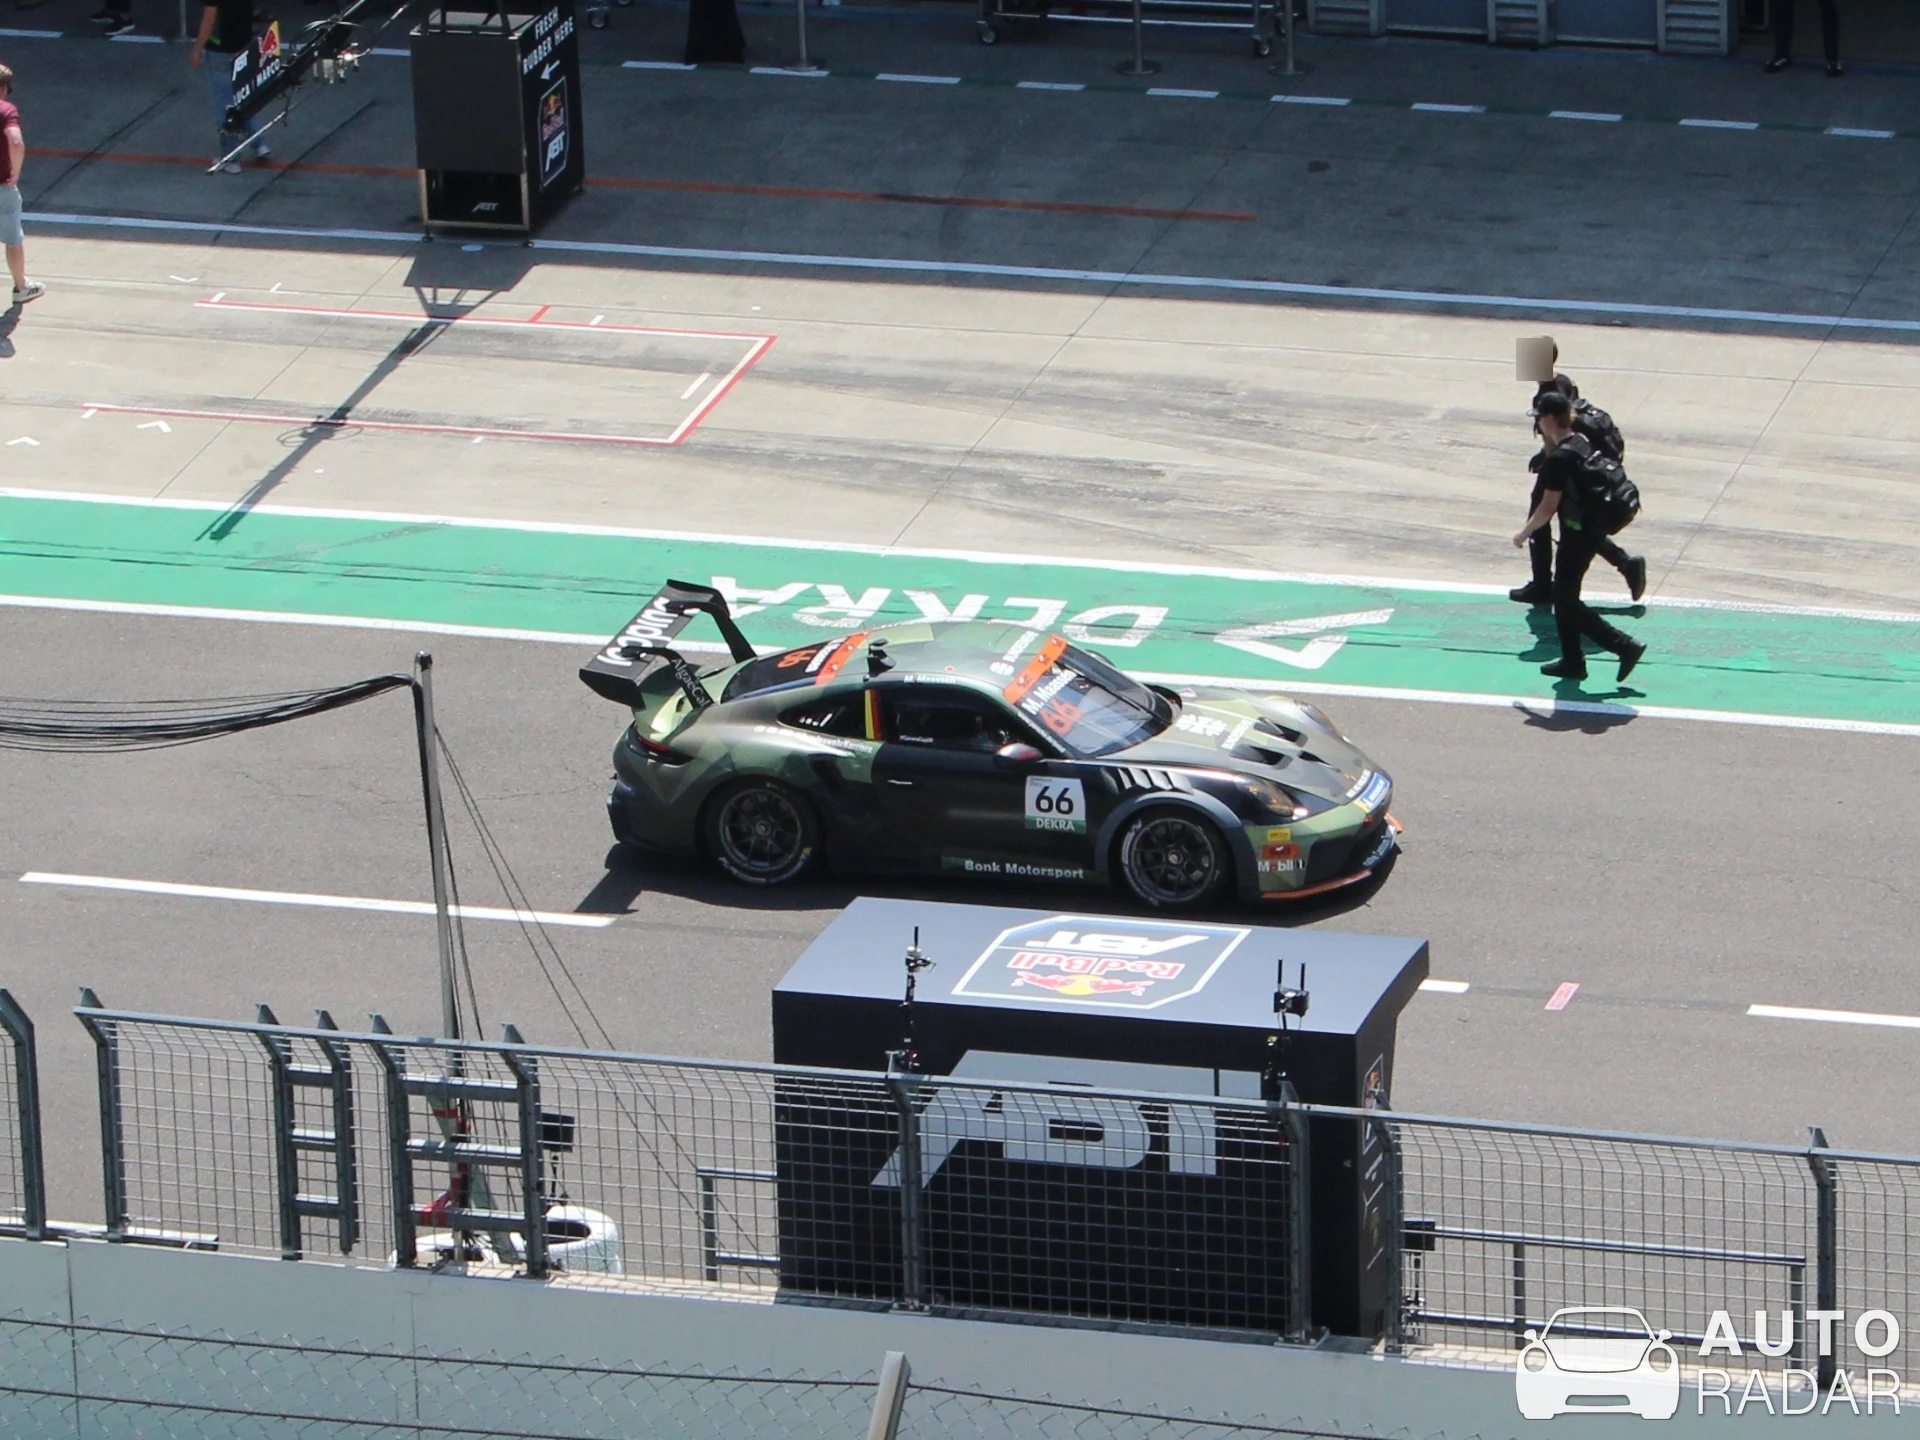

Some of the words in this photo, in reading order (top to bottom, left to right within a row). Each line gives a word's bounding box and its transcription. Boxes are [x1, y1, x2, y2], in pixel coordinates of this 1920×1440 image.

[535, 6, 559, 40] FRESH
[523, 36, 552, 75] RUBBER
[554, 16, 573, 46] HERE
[232, 83, 251, 106] LUCA
[256, 58, 281, 87] MARCO
[545, 130, 565, 172] ABT
[471, 202, 499, 213] ABT
[672, 659, 711, 707] AlgaeCal
[1021, 697, 1045, 716] M.
[1033, 669, 1077, 703] Maassen
[1039, 697, 1085, 735] 66
[1035, 785, 1074, 815] 66
[1036, 817, 1075, 831] DEKRA
[964, 859, 1001, 873] Bonk
[1005, 863, 1084, 879] Motorsport
[1025, 930, 1209, 956] ABT
[1007, 951, 1099, 975] Bull
[1096, 957, 1186, 980] Red
